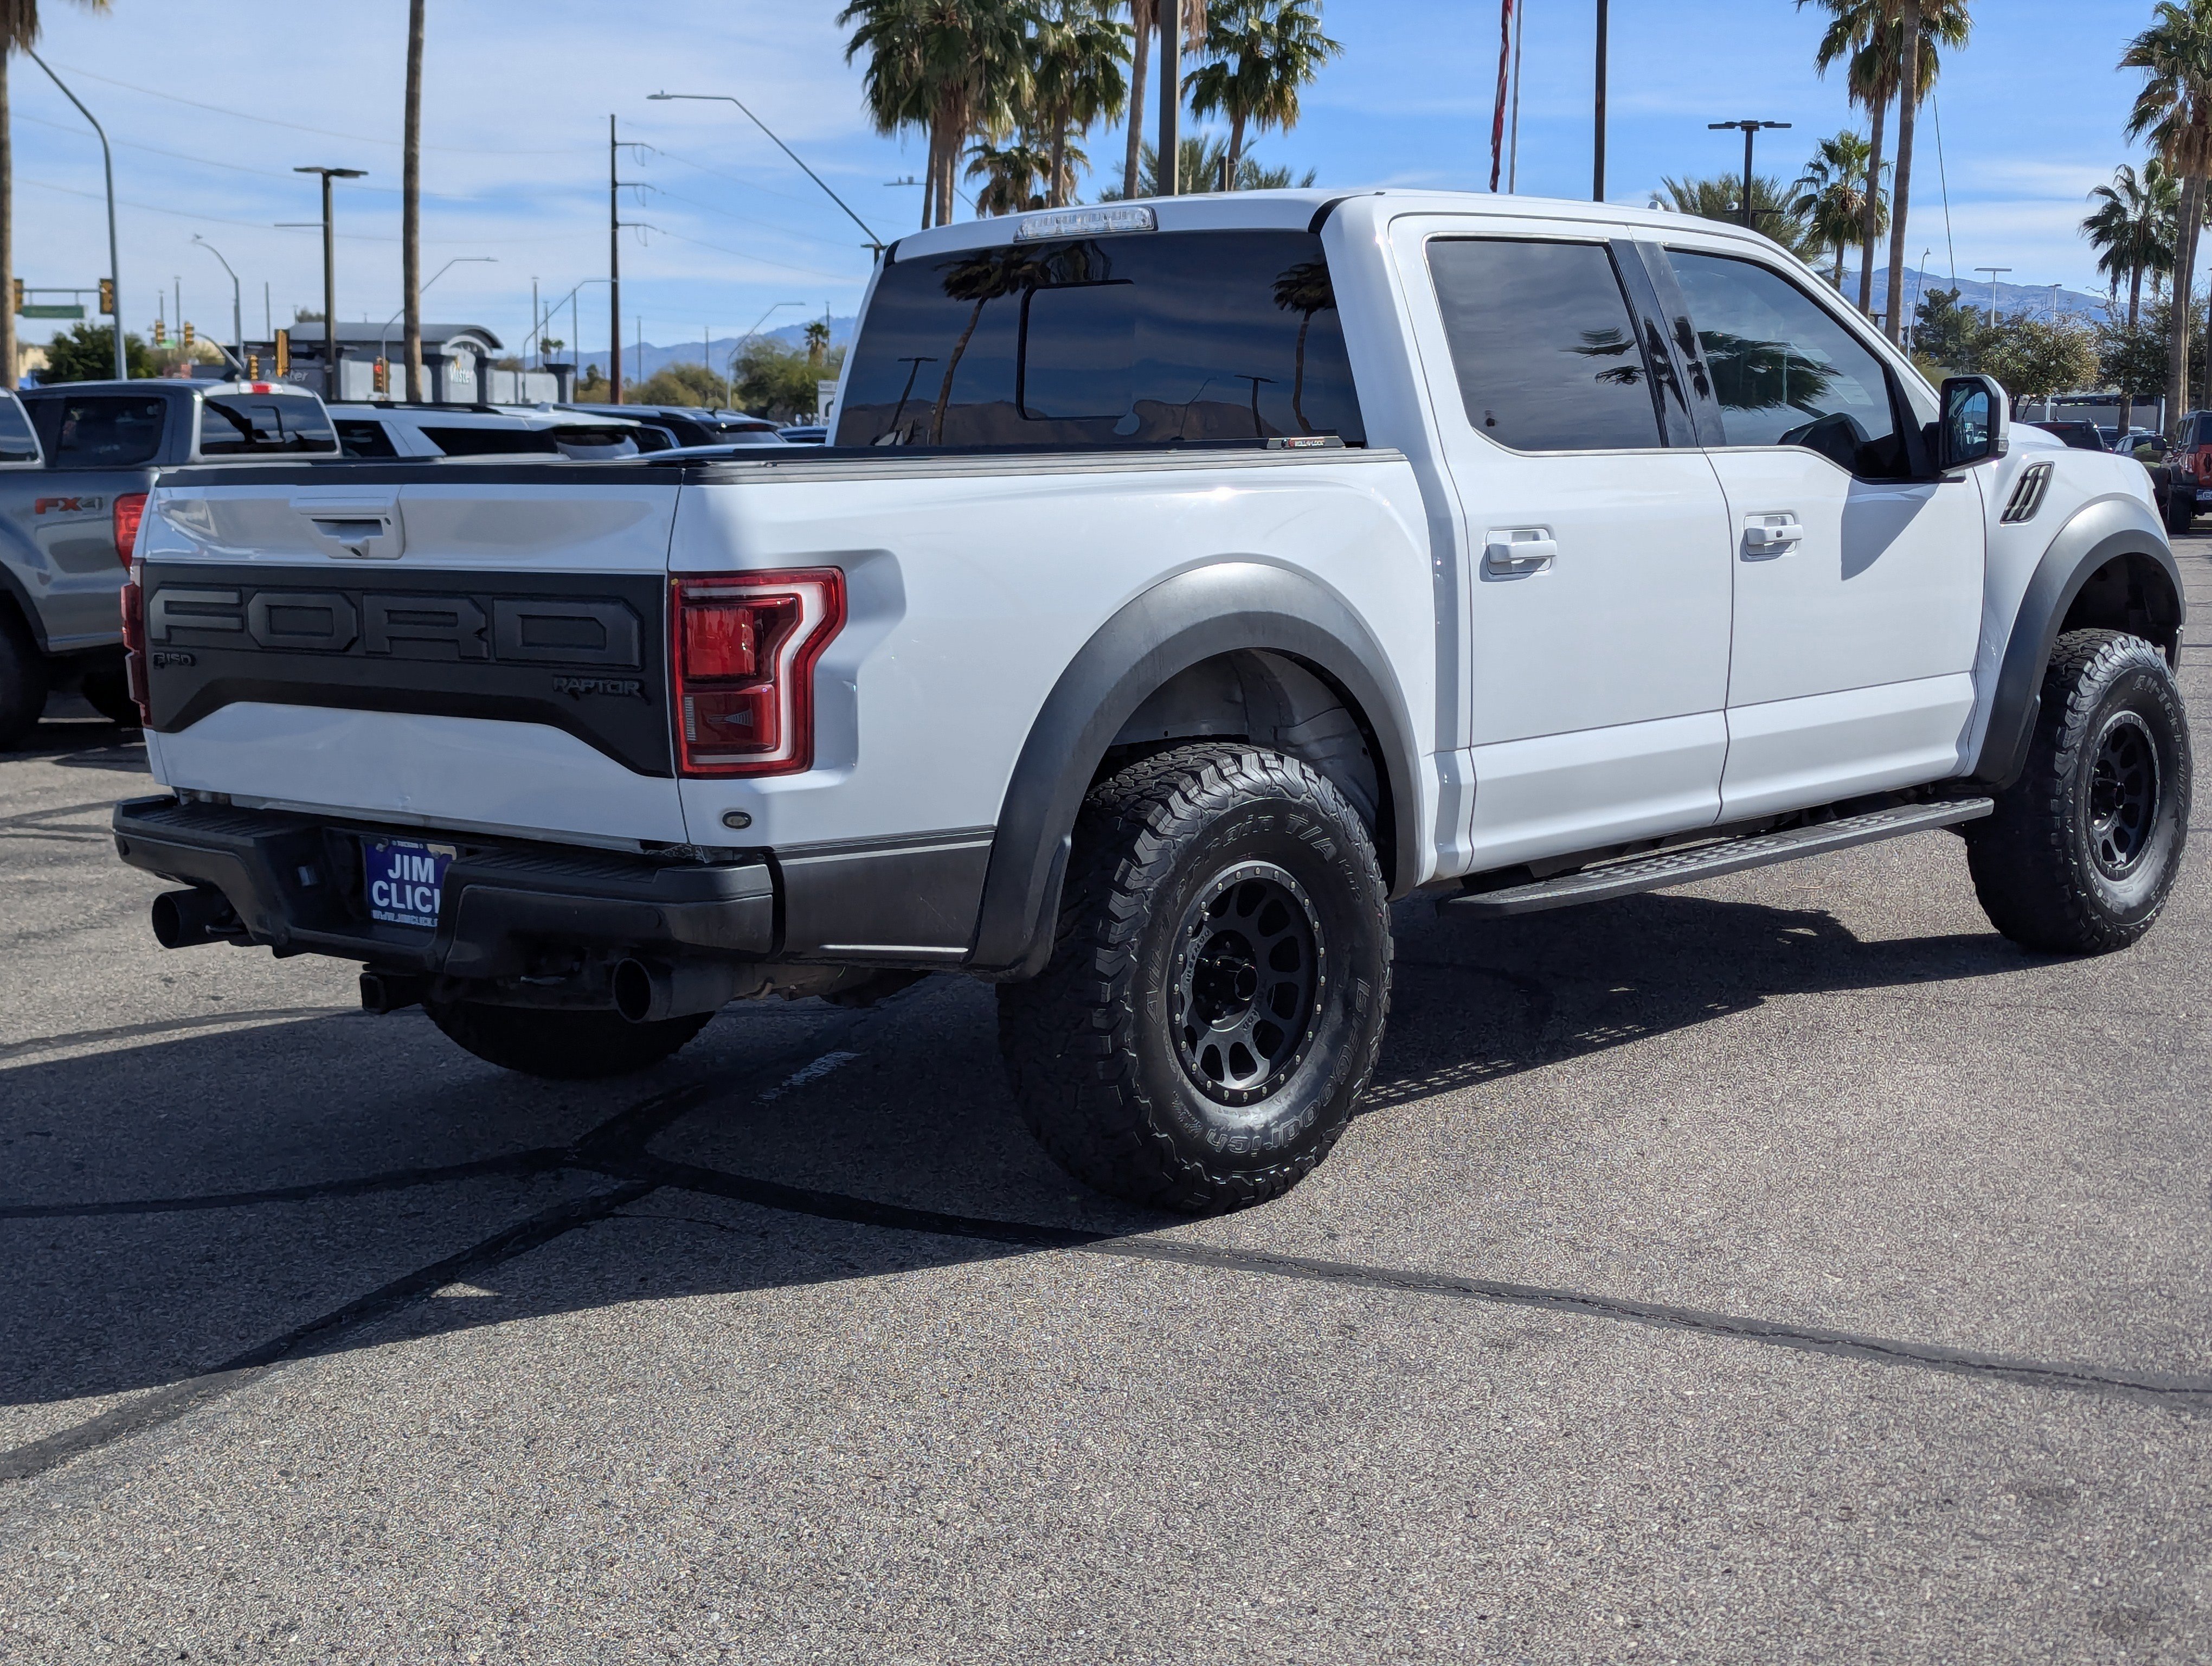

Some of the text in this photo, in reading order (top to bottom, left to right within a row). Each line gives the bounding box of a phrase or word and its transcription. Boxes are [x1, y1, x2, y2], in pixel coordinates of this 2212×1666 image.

[35, 497, 103, 514] FX4
[150, 587, 642, 669] FORD
[553, 677, 644, 700] RAPTOR
[388, 854, 434, 884] JIM
